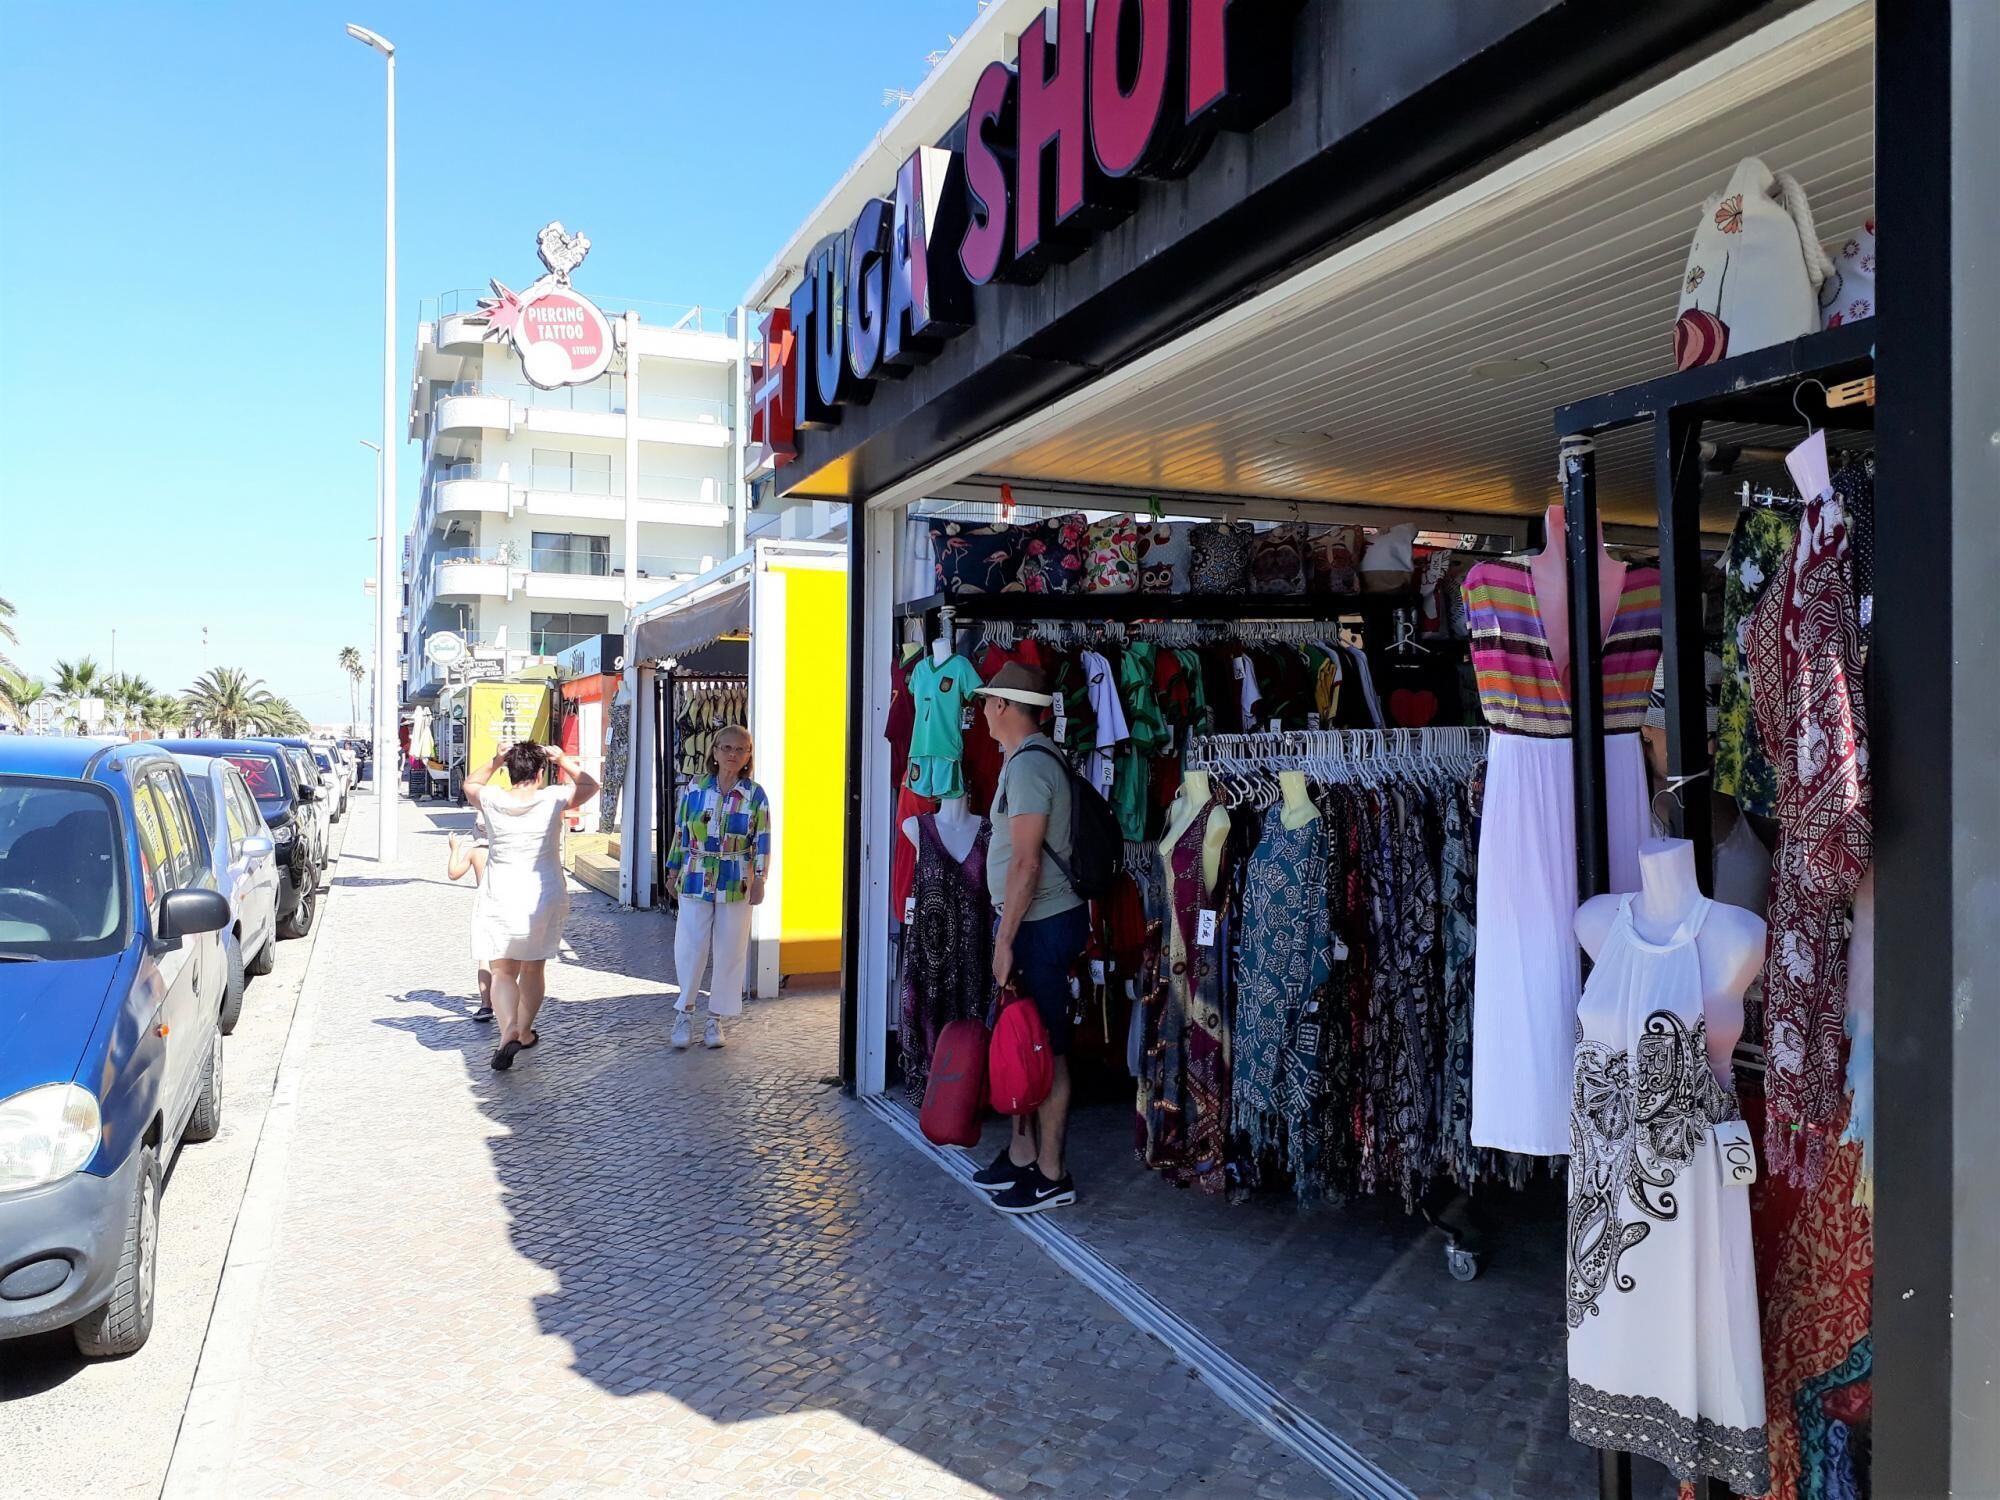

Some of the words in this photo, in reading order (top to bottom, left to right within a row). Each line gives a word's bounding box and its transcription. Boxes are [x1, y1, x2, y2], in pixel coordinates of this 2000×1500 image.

[790, 145, 932, 431] TUGA
[528, 307, 584, 322] PIERCING
[537, 324, 583, 339] TATTOO
[572, 345, 597, 356] STUDIO
[1723, 1136, 1753, 1180] 10€
